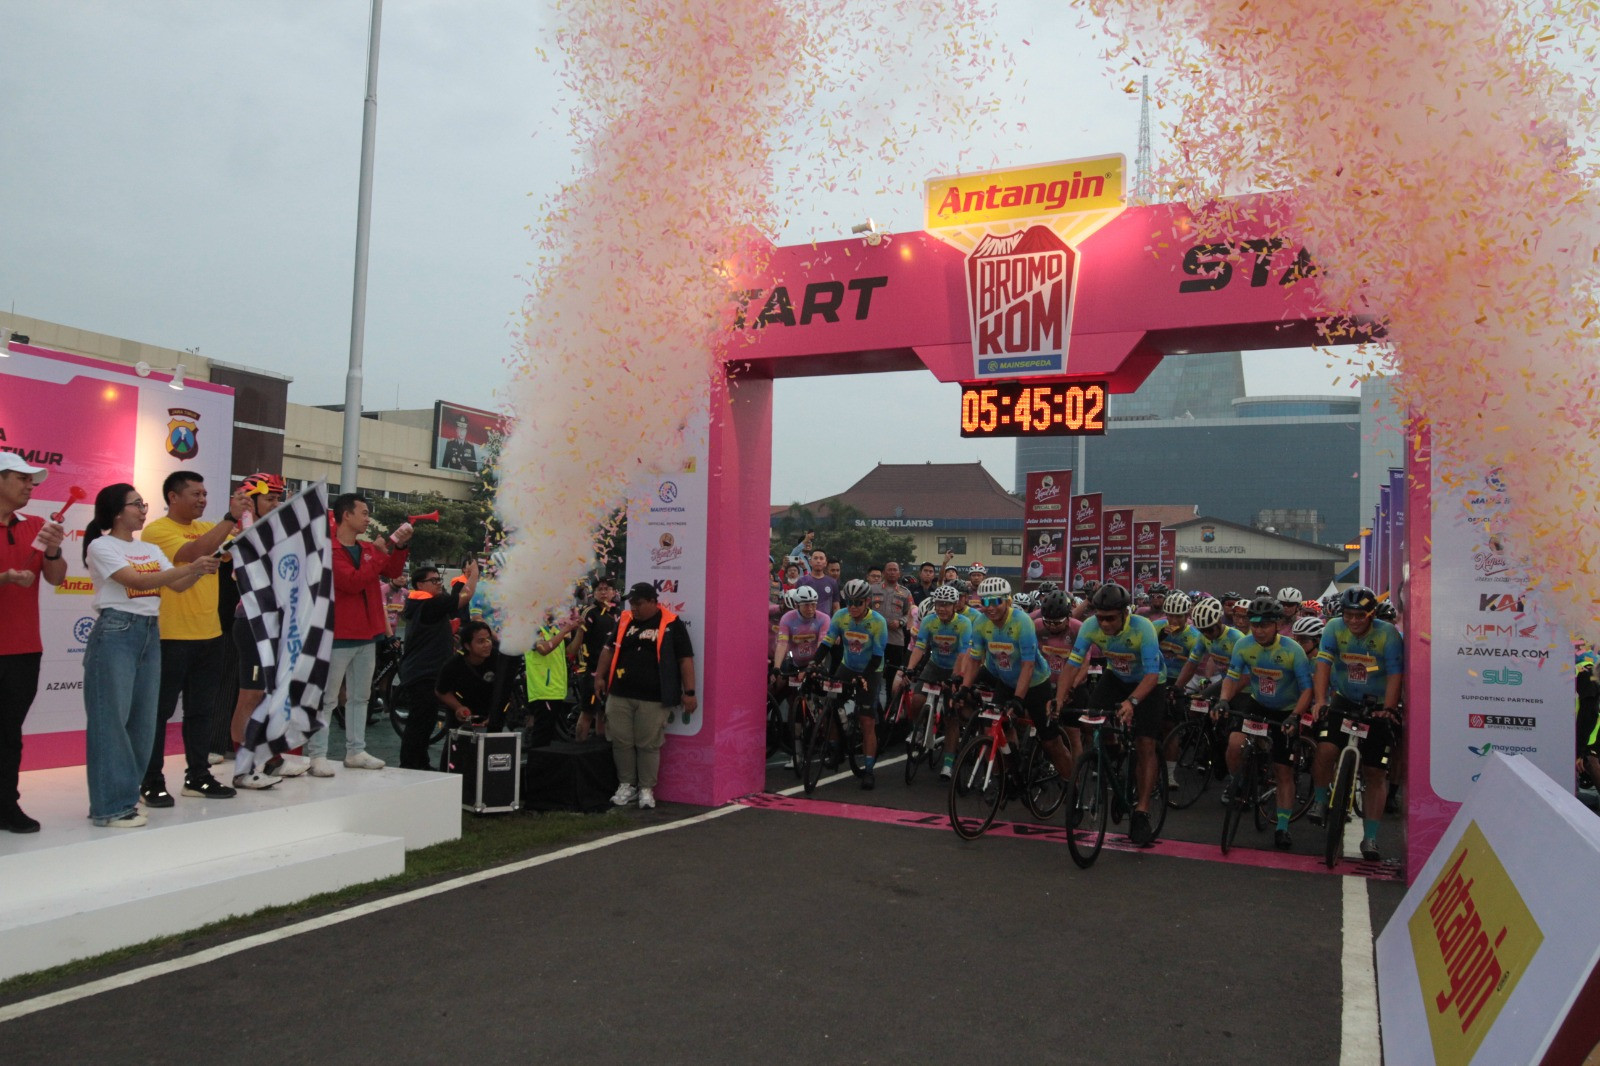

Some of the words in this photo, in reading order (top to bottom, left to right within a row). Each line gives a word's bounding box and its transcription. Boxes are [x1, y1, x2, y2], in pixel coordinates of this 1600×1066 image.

[937, 171, 1105, 217] Antangin
[979, 252, 1063, 320] BROMO
[978, 279, 1063, 355] KOM
[999, 359, 1052, 369] MAINSEPEDA
[961, 385, 1104, 432] 05:45:02
[886, 519, 934, 528] DITLANTAS
[653, 579, 679, 593] KAI
[1479, 593, 1525, 612] KAI
[1466, 624, 1512, 637] MPM
[1457, 647, 1549, 659] AZAWEAR.COM
[1486, 716, 1534, 726] STRIVE
[1491, 744, 1537, 753] mayapada
[1427, 848, 1508, 1035] Antangin
